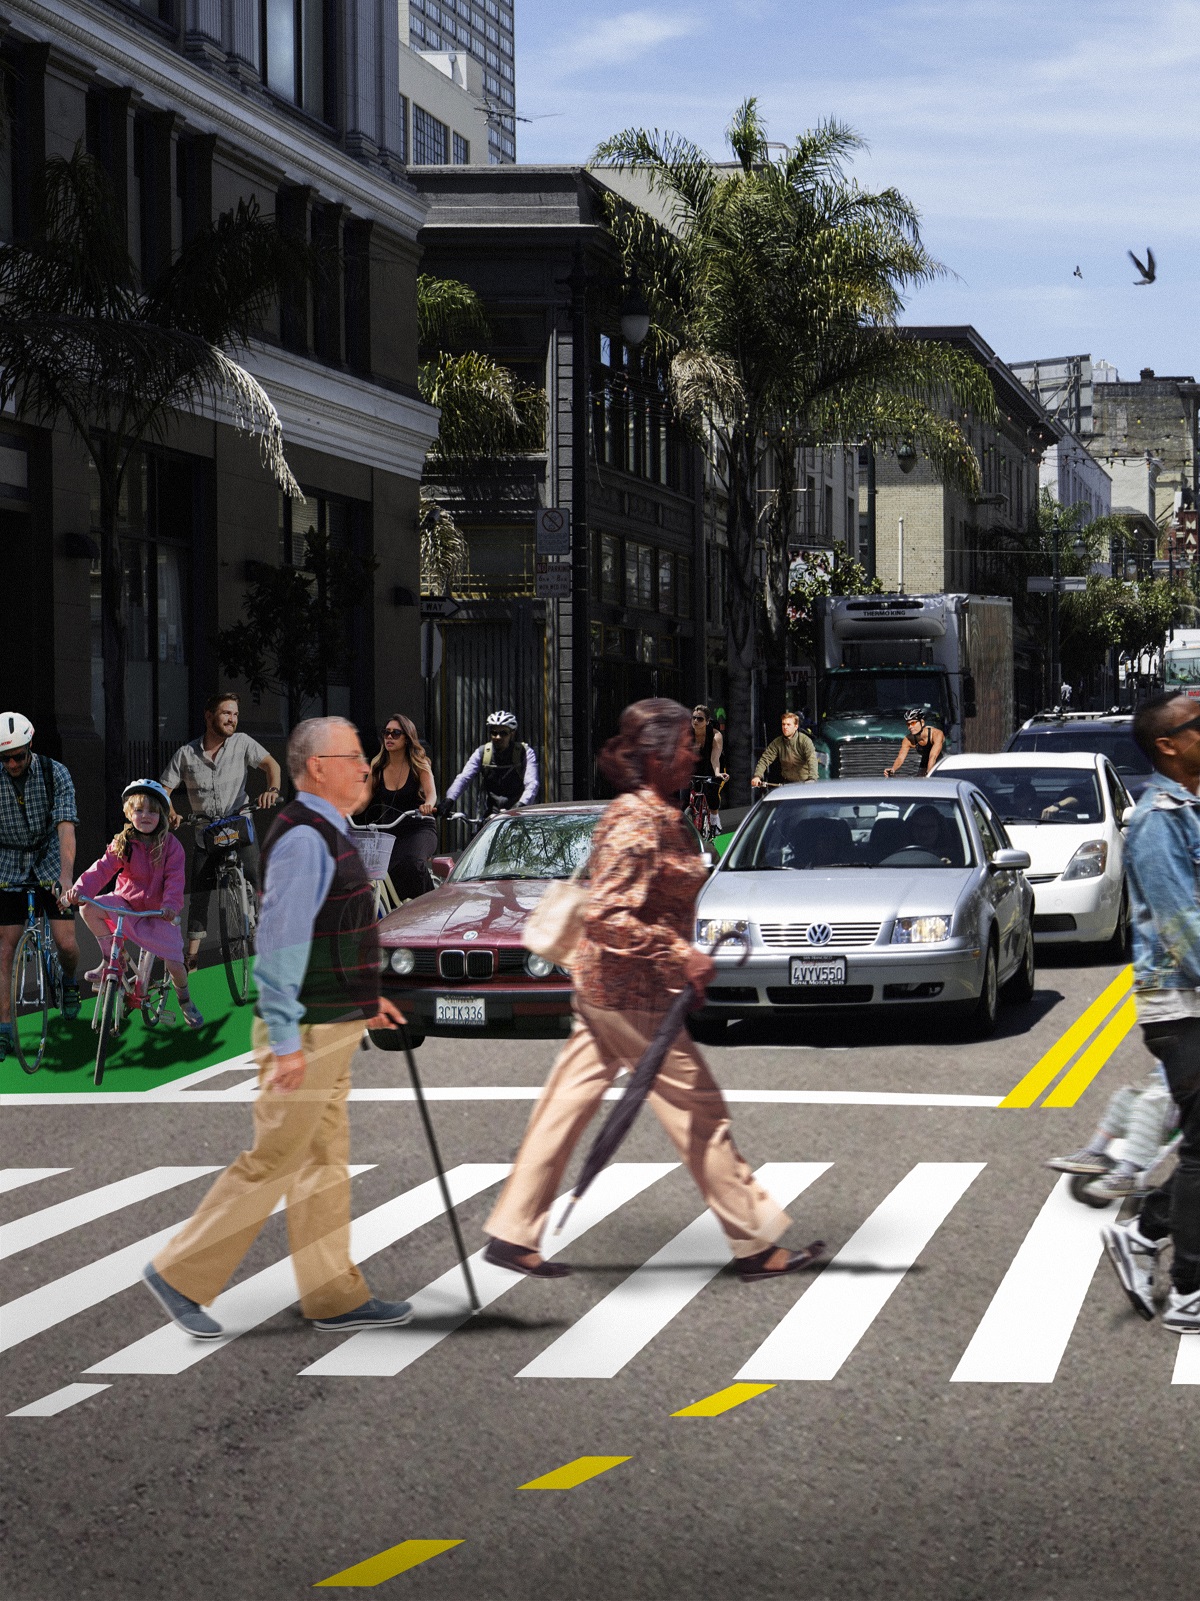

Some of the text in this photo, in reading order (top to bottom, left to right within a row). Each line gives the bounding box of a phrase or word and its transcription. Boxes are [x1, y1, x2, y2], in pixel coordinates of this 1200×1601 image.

[426, 603, 443, 611] WAY
[793, 966, 843, 981] 4VYV550
[438, 1005, 483, 1020] 3CIK336
